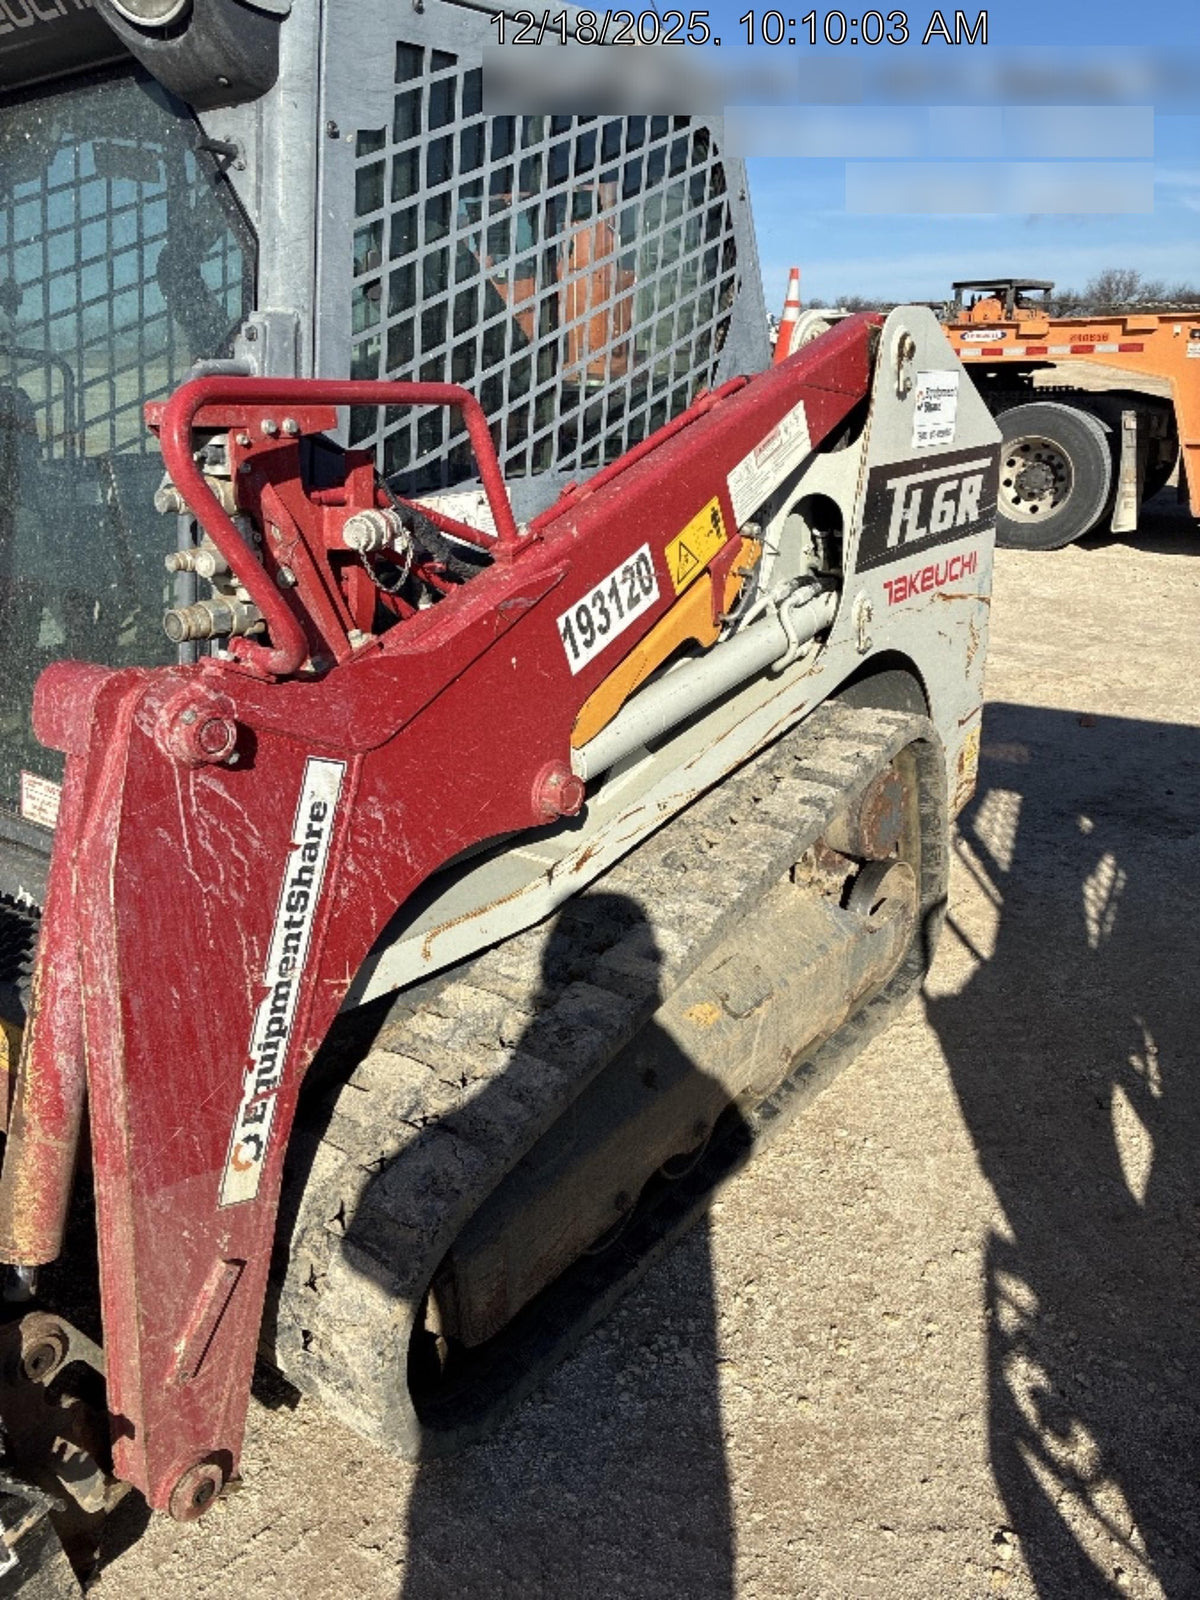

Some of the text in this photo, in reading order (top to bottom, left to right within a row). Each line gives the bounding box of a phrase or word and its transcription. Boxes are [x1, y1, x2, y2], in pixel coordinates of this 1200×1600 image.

[886, 456, 993, 548] TL6R
[562, 552, 654, 659] 193120
[241, 800, 328, 1127] EquipmentShare
